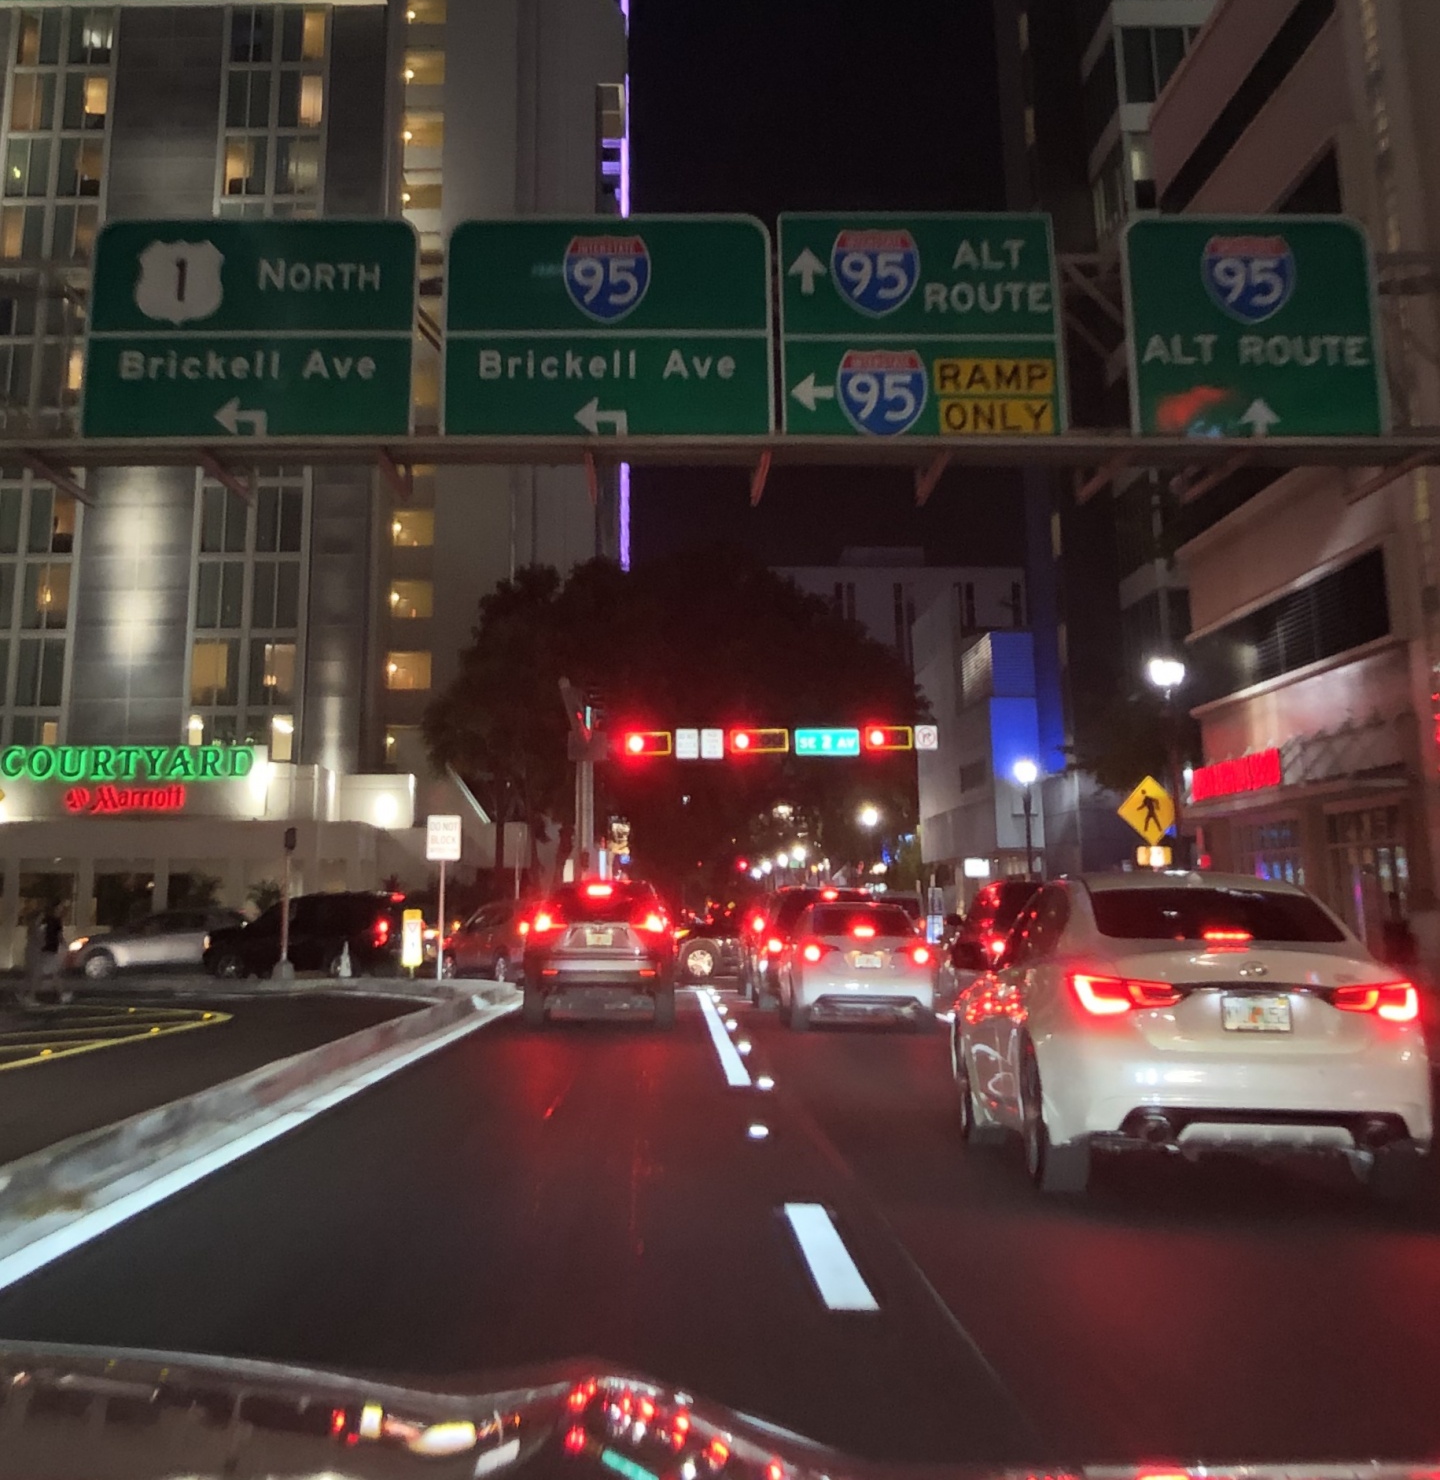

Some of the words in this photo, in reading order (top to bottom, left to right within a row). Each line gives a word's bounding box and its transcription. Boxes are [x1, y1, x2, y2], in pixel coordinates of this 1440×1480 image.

[952, 239, 1026, 271] ALT
[175, 257, 187, 302] 1
[258, 257, 381, 292] NORTH
[573, 257, 638, 306] 95
[841, 252, 909, 299] 95
[1212, 258, 1285, 307] 95
[924, 281, 1051, 314] ROUTE
[118, 348, 281, 380] Brickell
[302, 348, 376, 380] Ave
[479, 348, 636, 380] Brickell
[662, 348, 736, 380] Ave
[1142, 334, 1219, 366] ALT
[1239, 334, 1372, 367] ROUTE
[938, 362, 1049, 390] RAMP
[847, 372, 917, 421] 95
[943, 401, 1049, 431] ONLY
[799, 737, 817, 749] SE
[0, 746, 256, 781] COURTYARD
[66, 784, 186, 813] Marriott
[430, 821, 441, 831] DO
[442, 821, 458, 831] NOT
[430, 834, 456, 845] BLOCK
